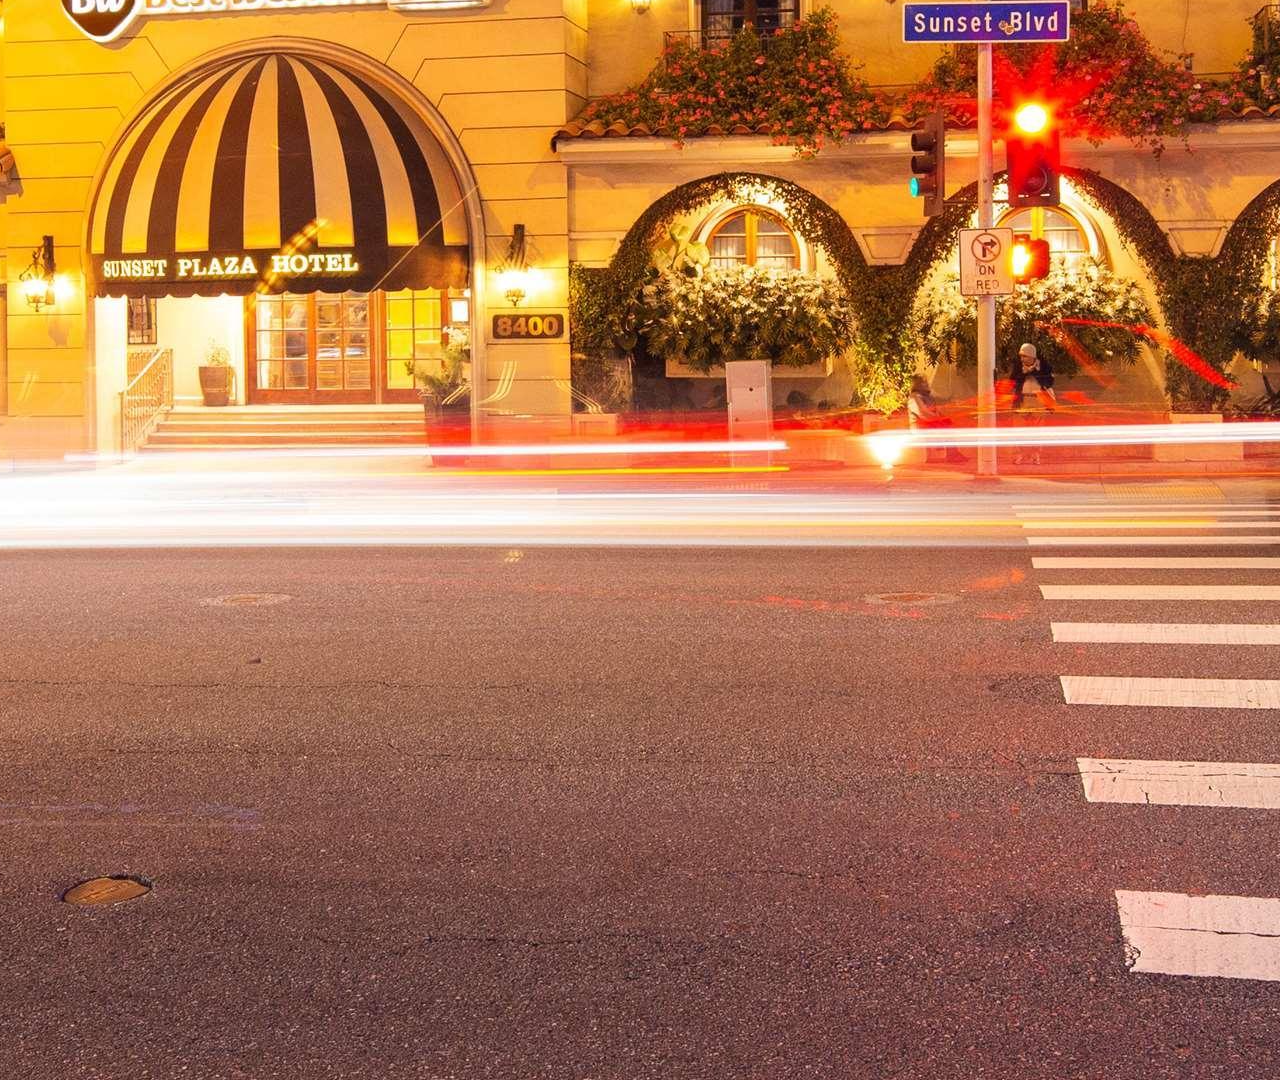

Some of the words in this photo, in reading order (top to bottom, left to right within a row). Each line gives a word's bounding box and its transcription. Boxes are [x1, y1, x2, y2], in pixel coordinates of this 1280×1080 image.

[914, 12, 993, 33] Sunset
[1010, 10, 1058, 32] Blvd
[103, 259, 168, 278] SUNSET
[177, 256, 258, 276] PLAZA
[271, 253, 360, 274] HOTEL
[978, 265, 996, 276] ON
[976, 279, 1000, 290] RED
[497, 316, 558, 336] 8400
